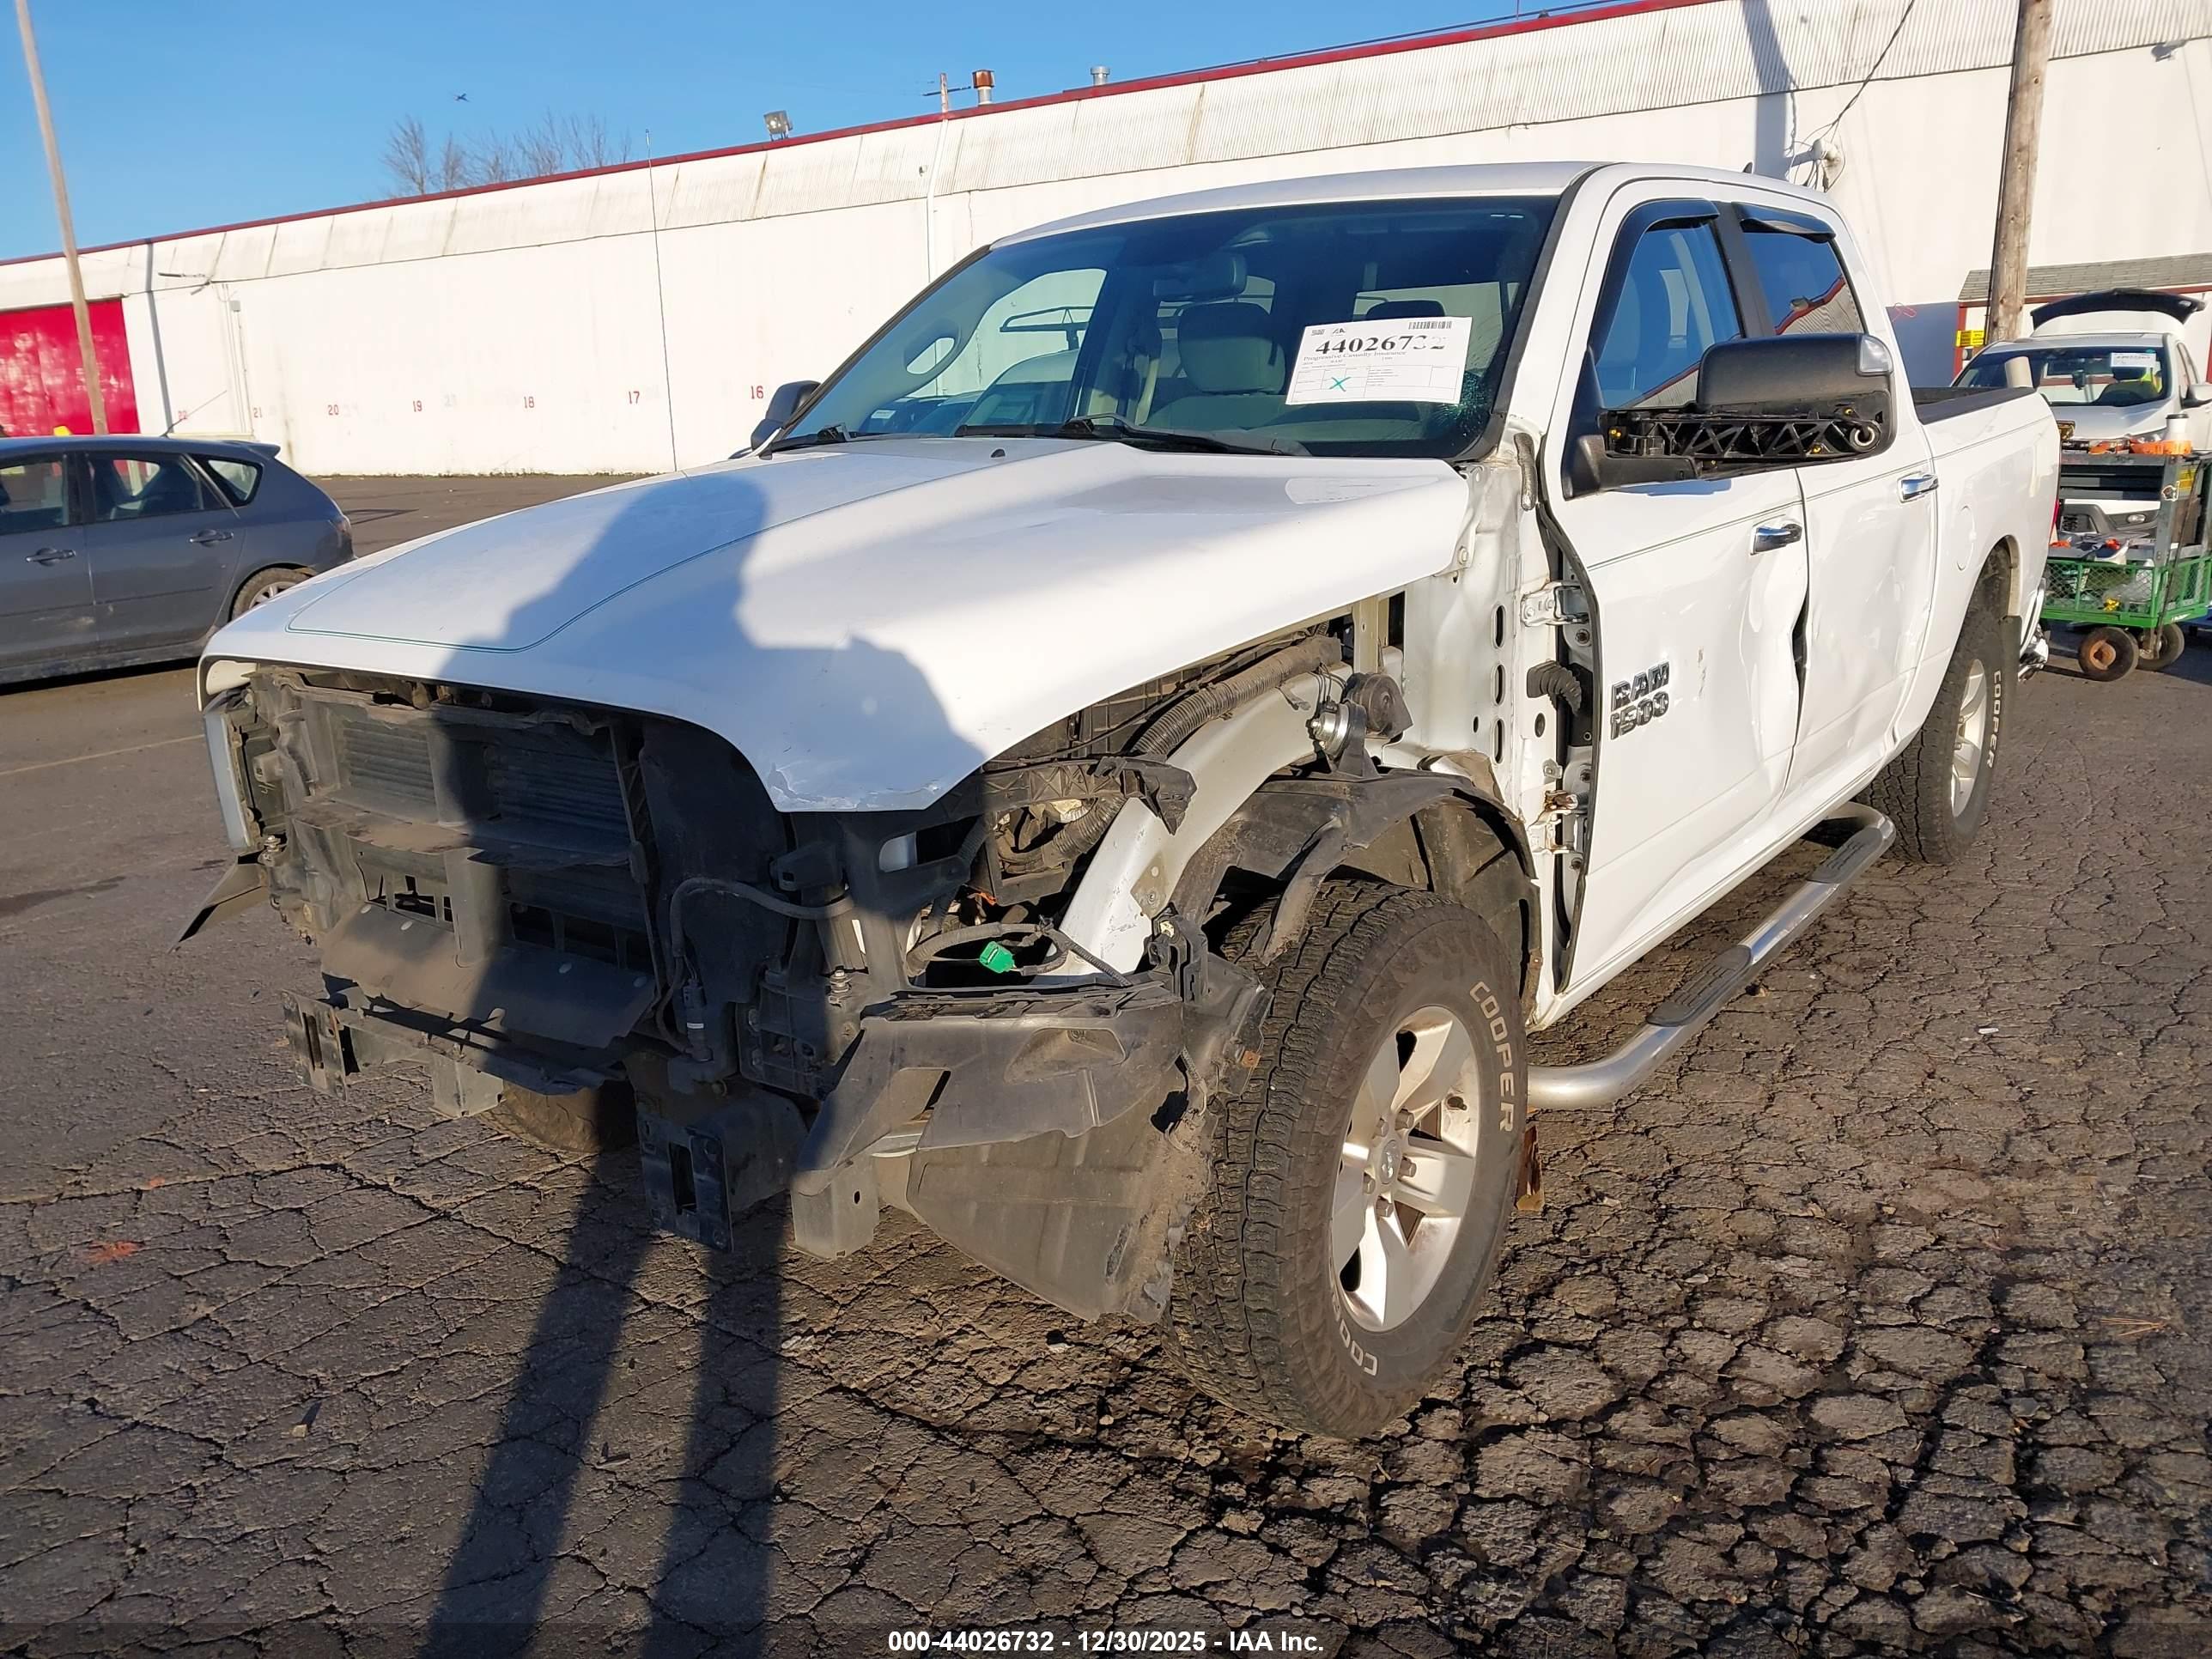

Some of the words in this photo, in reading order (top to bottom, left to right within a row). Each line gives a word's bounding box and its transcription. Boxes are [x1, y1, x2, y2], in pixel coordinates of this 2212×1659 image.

[1316, 334, 1445, 355] 44026732
[629, 391, 640, 404] 17
[750, 385, 764, 399] 16
[413, 400, 422, 412] 19
[524, 396, 535, 409] 18
[253, 407, 263, 418] 21
[327, 404, 340, 416] 20
[1611, 661, 1669, 712] RAM
[1610, 691, 1669, 740] 1500
[1986, 670, 2002, 769] COOPER
[1469, 981, 1515, 1132] COOPER
